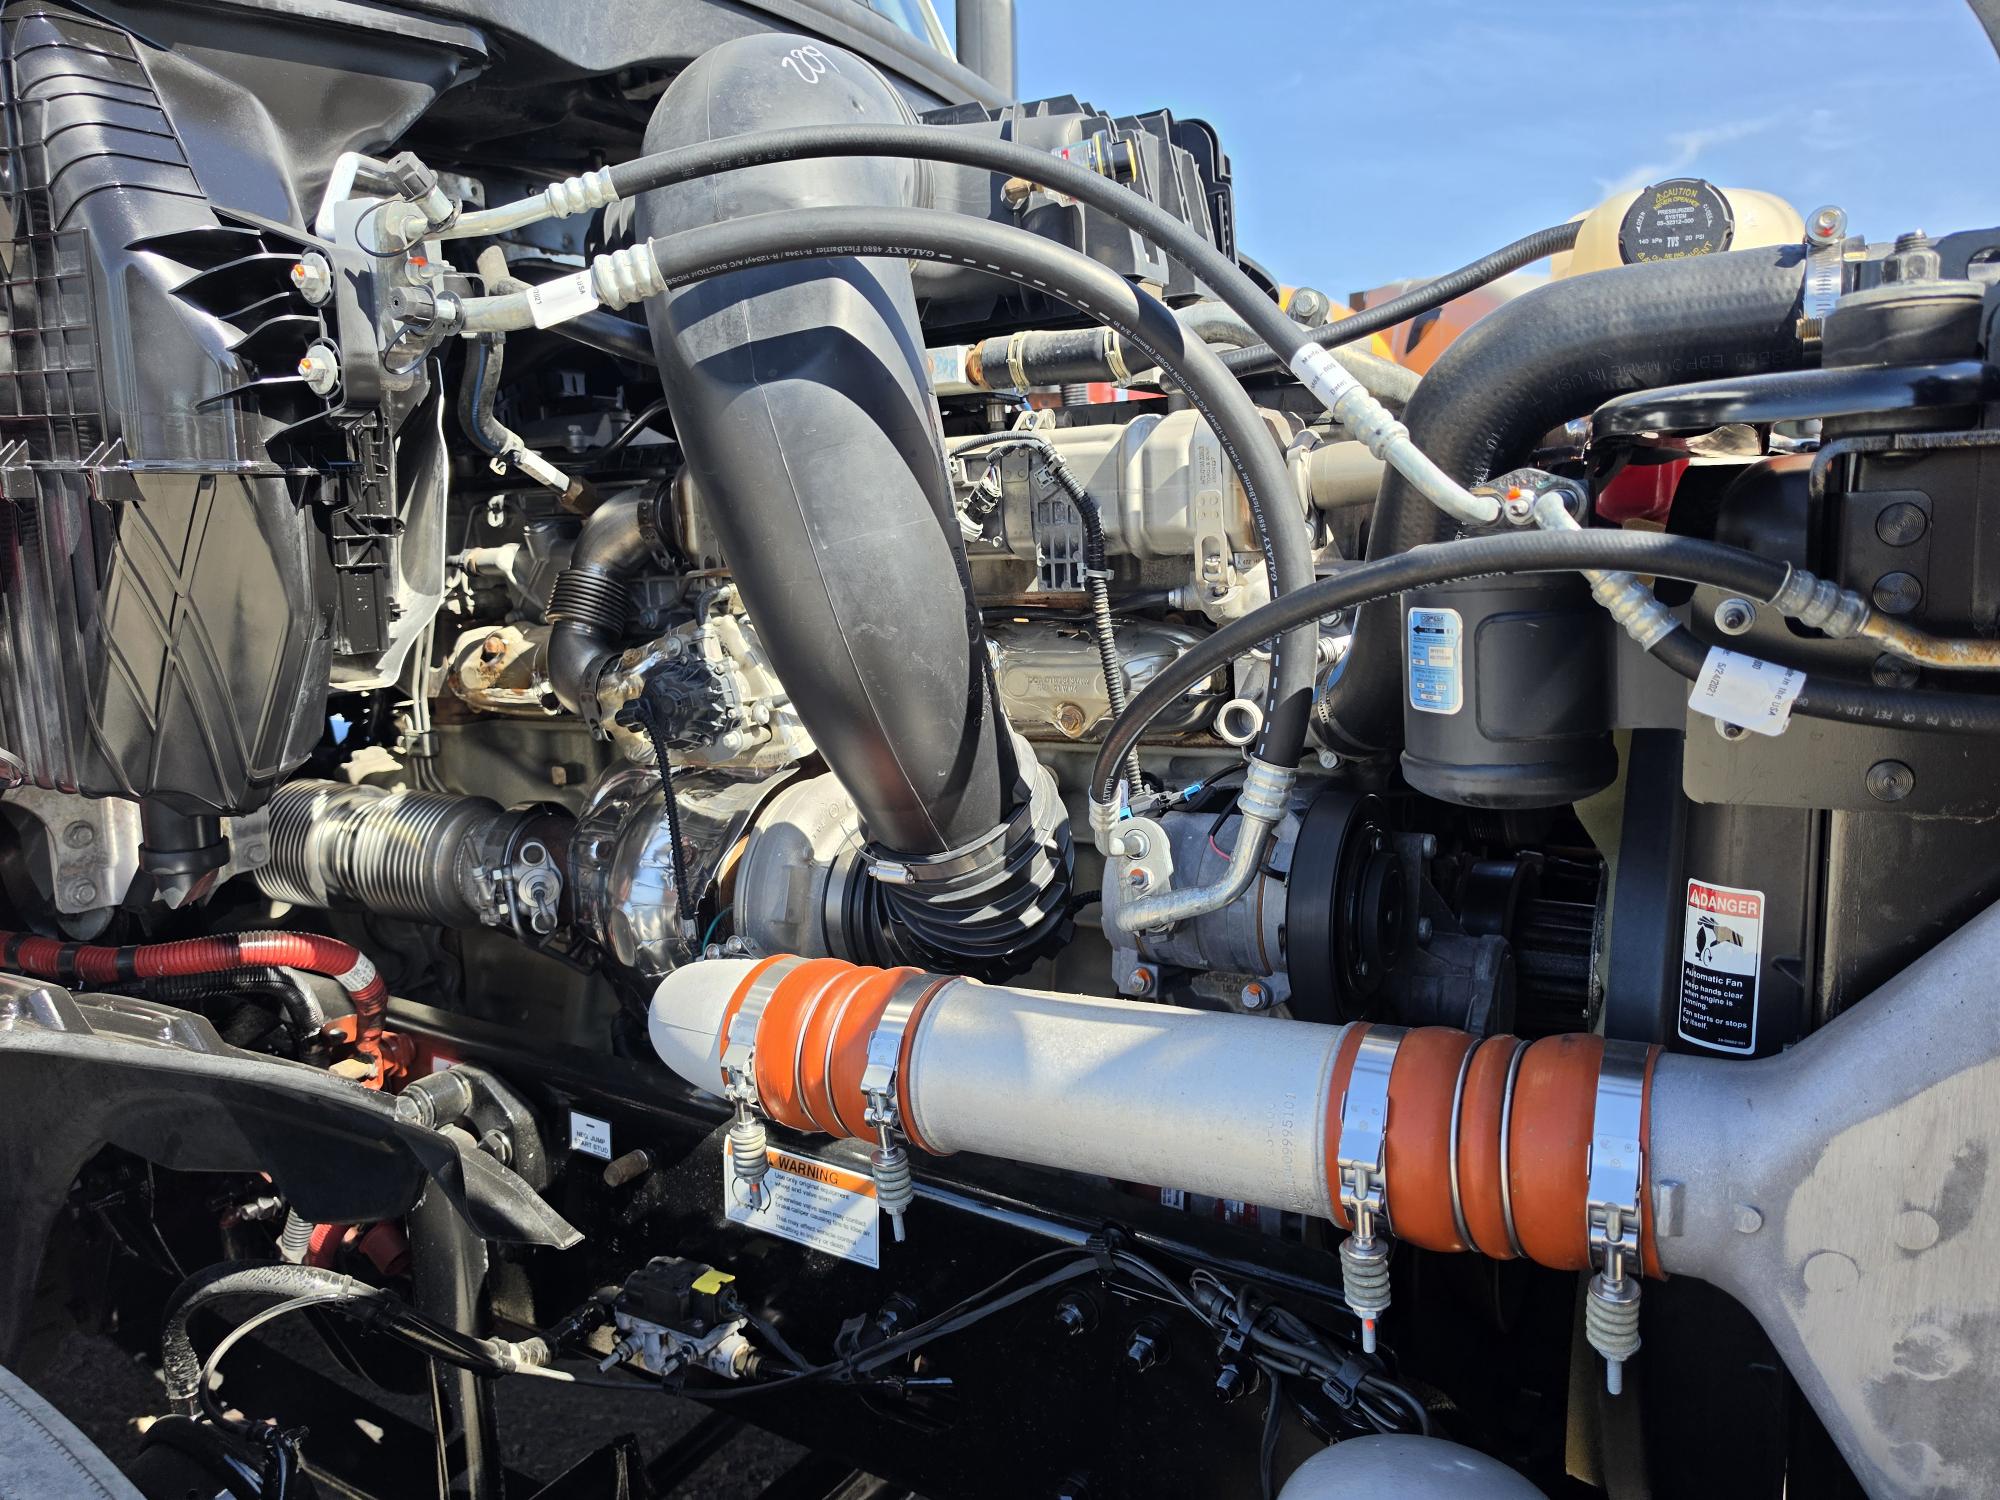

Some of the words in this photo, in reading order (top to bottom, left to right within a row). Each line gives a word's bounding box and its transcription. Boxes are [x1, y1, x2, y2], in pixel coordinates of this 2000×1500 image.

[1663, 187, 1698, 198] CAUTION
[885, 246, 935, 257] GALAXY
[692, 263, 728, 278] SUCTION
[1154, 354, 1174, 374] HOSE
[1173, 371, 1200, 401] SUCTION
[1263, 536, 1278, 581] GALAXY
[1706, 663, 1726, 697] 5/24/2021
[1775, 687, 1786, 700] the
[1768, 701, 1781, 716] USA
[1874, 710, 1893, 721] PET
[1103, 779, 1114, 801] GALAXY
[1701, 893, 1758, 915] DANGER
[1685, 968, 1724, 985] Automatic
[1726, 978, 1743, 988] Fan
[1684, 989, 1699, 998] when
[1700, 994, 1724, 1005] engine
[1685, 980, 1699, 991] Keep
[1701, 985, 1722, 996] hands
[1724, 991, 1743, 1000] clear
[1684, 997, 1708, 1010] running.
[1682, 1016, 1689, 1024] by
[1690, 1019, 1708, 1030] itself.
[1683, 1007, 1693, 1016] Fan
[1694, 1012, 1714, 1023] starts
[1725, 1020, 1748, 1029] stops
[590, 1136, 605, 1144] JUMP
[593, 1144, 608, 1153] STUD
[778, 1156, 839, 1185] WARNING
[775, 1172, 785, 1180] Use
[786, 1176, 797, 1185] only
[799, 1181, 819, 1190] original
[775, 1193, 801, 1207] Otherwise
[803, 1202, 818, 1211] valve
[819, 1208, 832, 1216] stem
[833, 1212, 844, 1220] may
[776, 1214, 787, 1222] This
[788, 1219, 799, 1228] may
[800, 1223, 815, 1232] affect
[791, 1207, 808, 1216] caliper
[810, 1214, 831, 1225] causing
[776, 1224, 799, 1236] resulting
